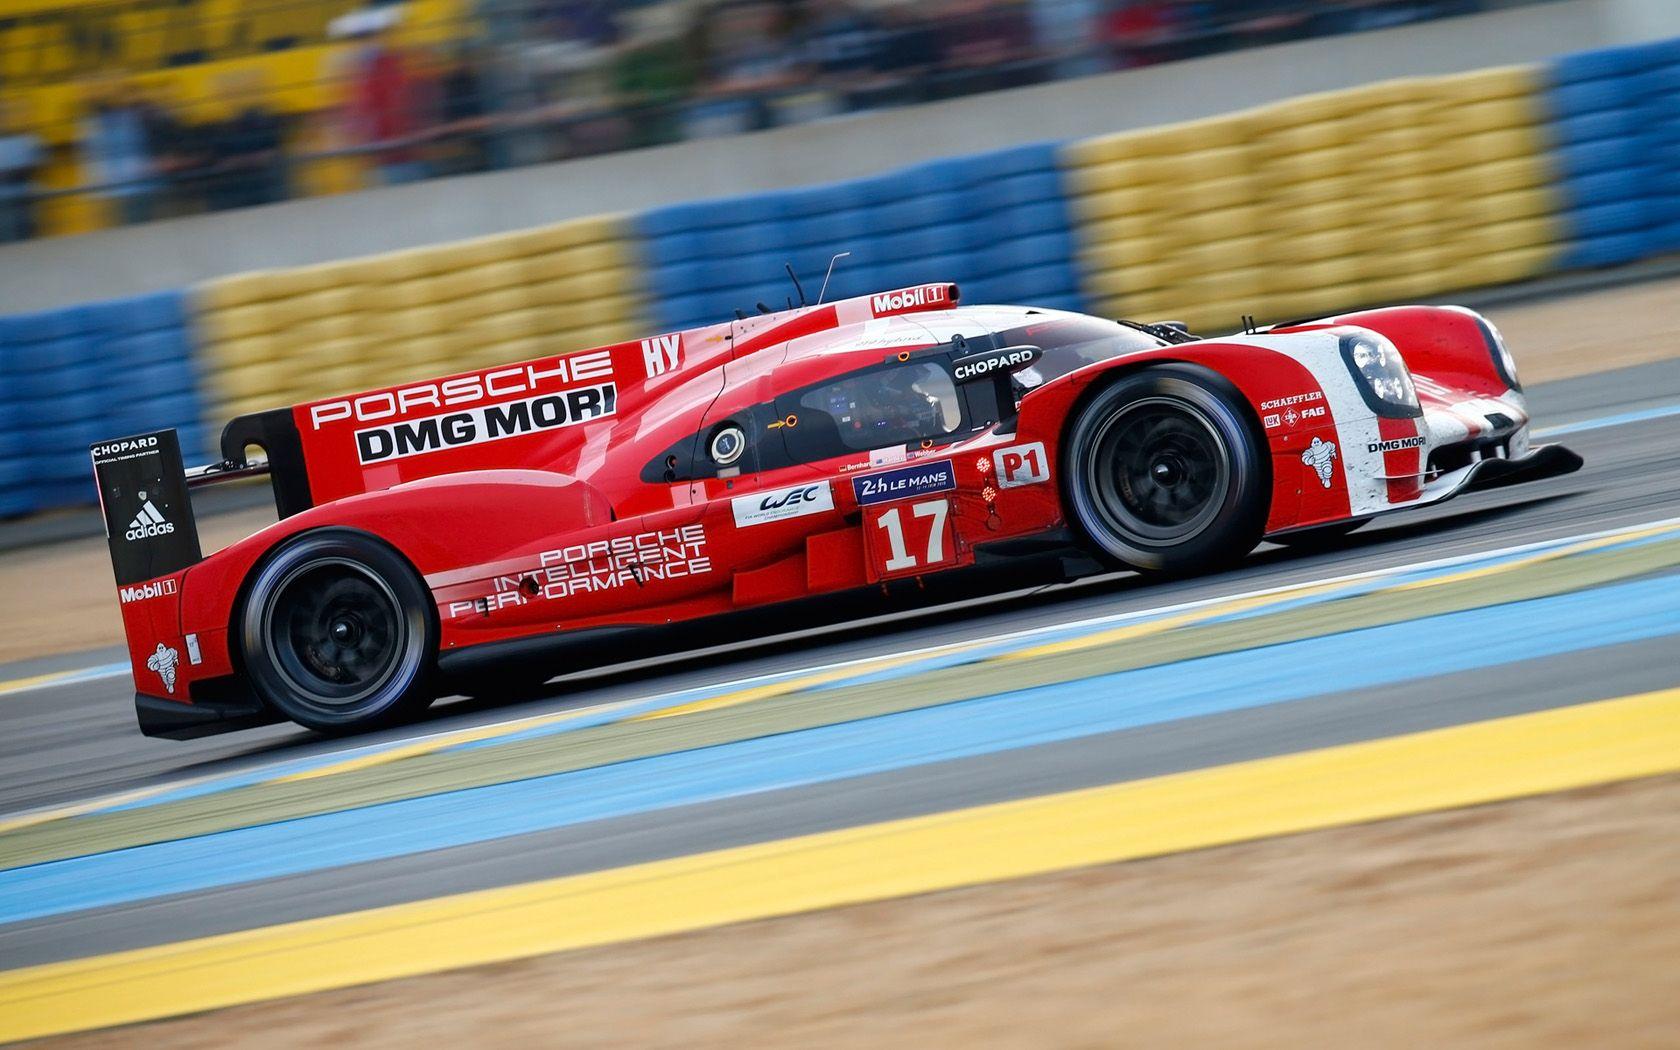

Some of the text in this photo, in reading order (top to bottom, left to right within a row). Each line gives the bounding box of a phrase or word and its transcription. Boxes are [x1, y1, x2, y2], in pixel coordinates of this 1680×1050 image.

[875, 289, 925, 313] Mobil
[641, 334, 680, 378] HY
[954, 350, 1033, 379] CHOPARD
[310, 351, 612, 430] PORSCHE
[1261, 391, 1322, 410] SCHAEFFLER
[357, 384, 616, 462] DMG MORI
[1301, 406, 1325, 419] FAG
[93, 437, 158, 456] CHOPARD
[136, 449, 159, 457] PARTNER
[1368, 437, 1426, 453] DMG MORI
[1003, 449, 1041, 481] P1
[890, 479, 906, 490] LE
[909, 472, 947, 487] MANS
[760, 486, 819, 511] WEC
[126, 521, 174, 541] adidas
[877, 498, 949, 571] 17
[540, 524, 706, 567] PORSCHE
[121, 581, 162, 603] Mobil
